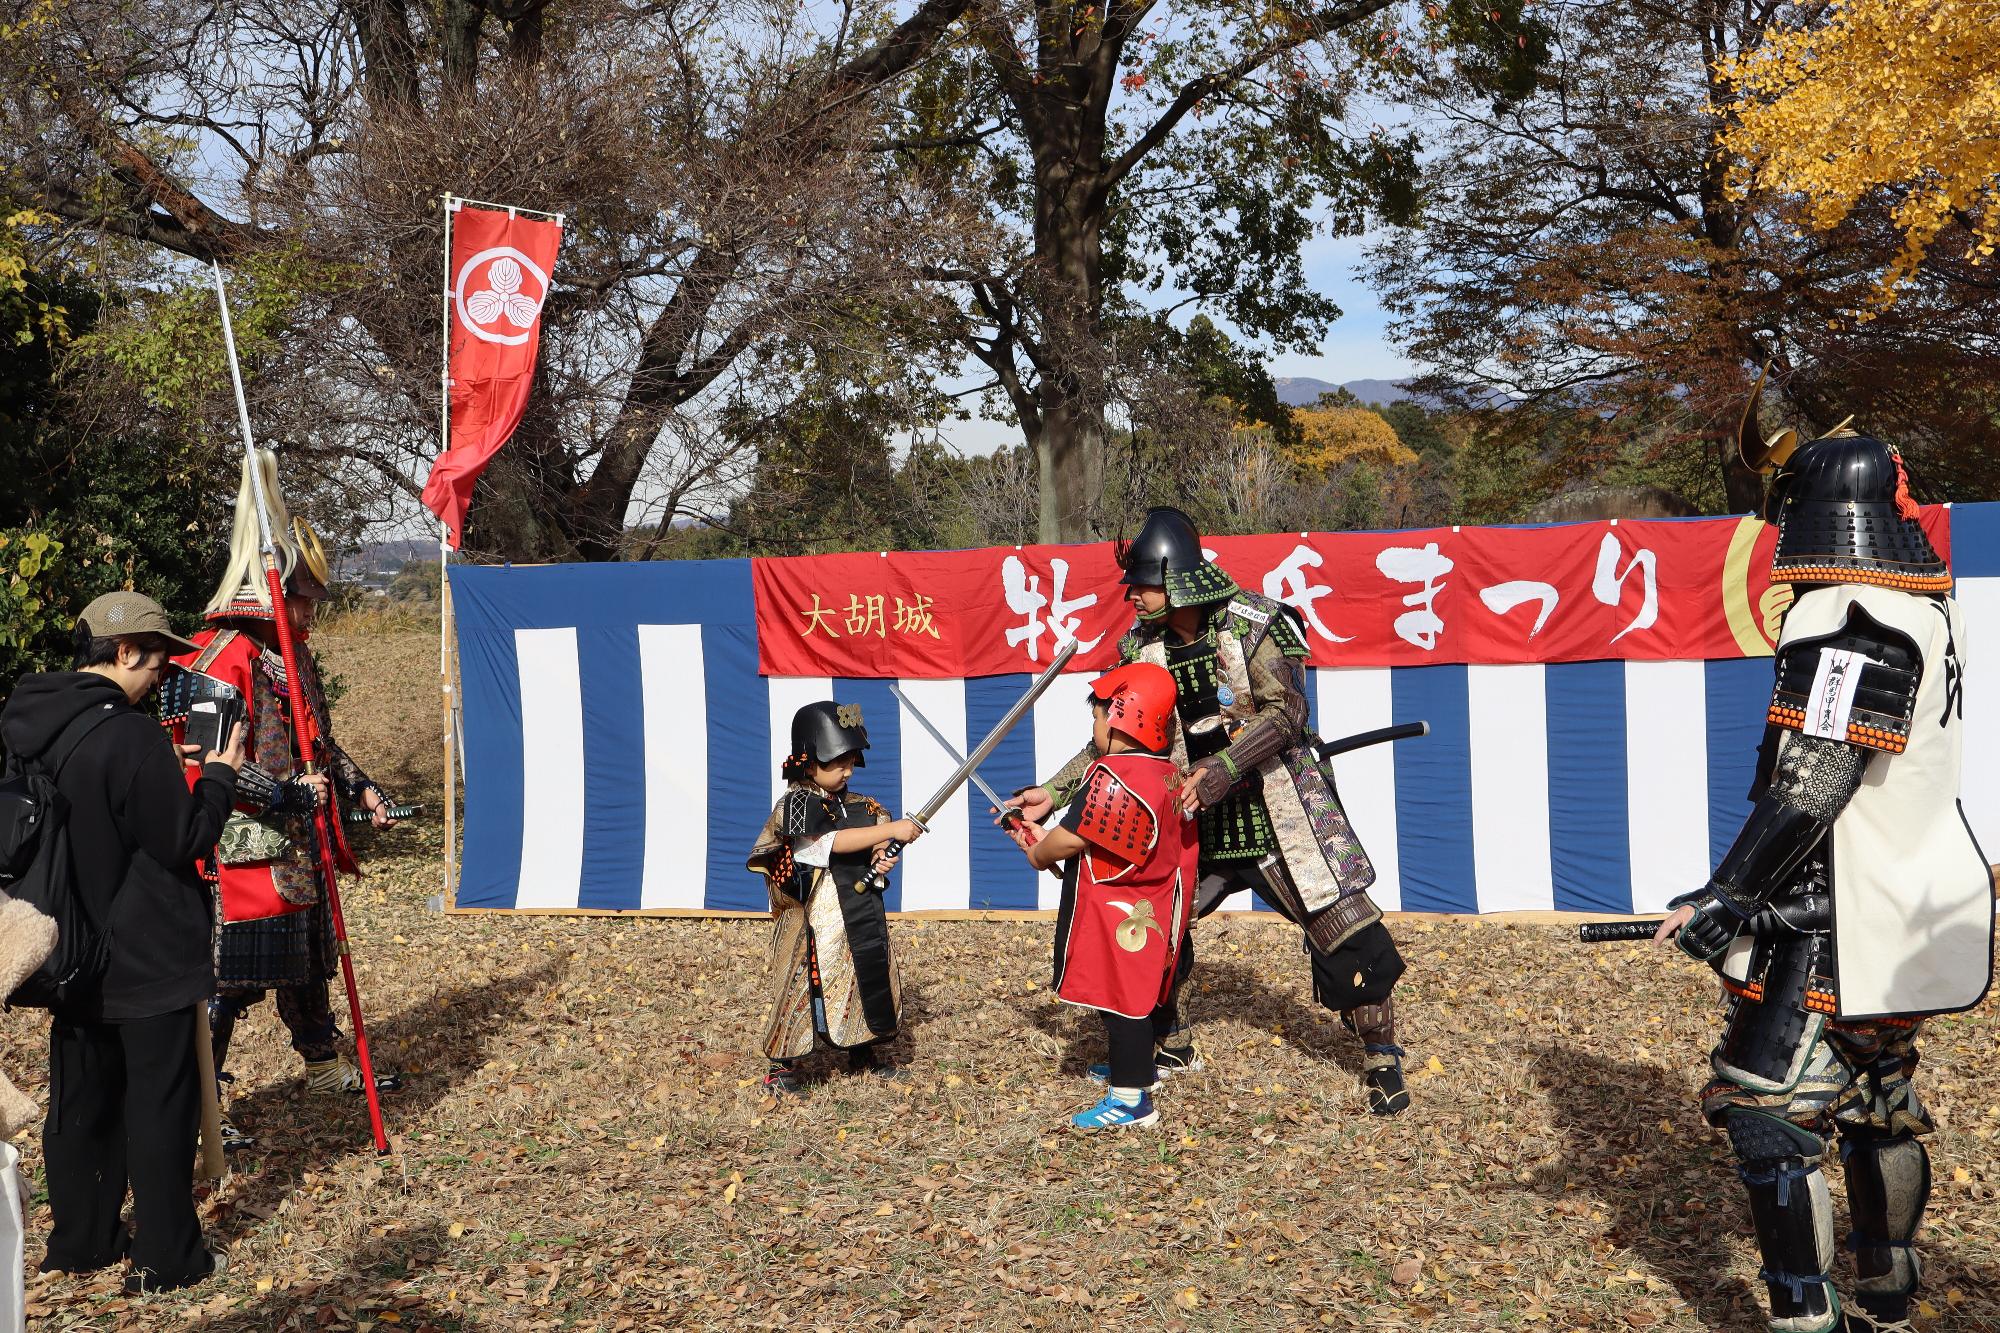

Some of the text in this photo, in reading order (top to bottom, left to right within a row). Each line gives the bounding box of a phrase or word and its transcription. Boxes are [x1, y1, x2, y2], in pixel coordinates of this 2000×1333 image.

[800, 531, 1659, 662] 大胡城 牧氏まつり
